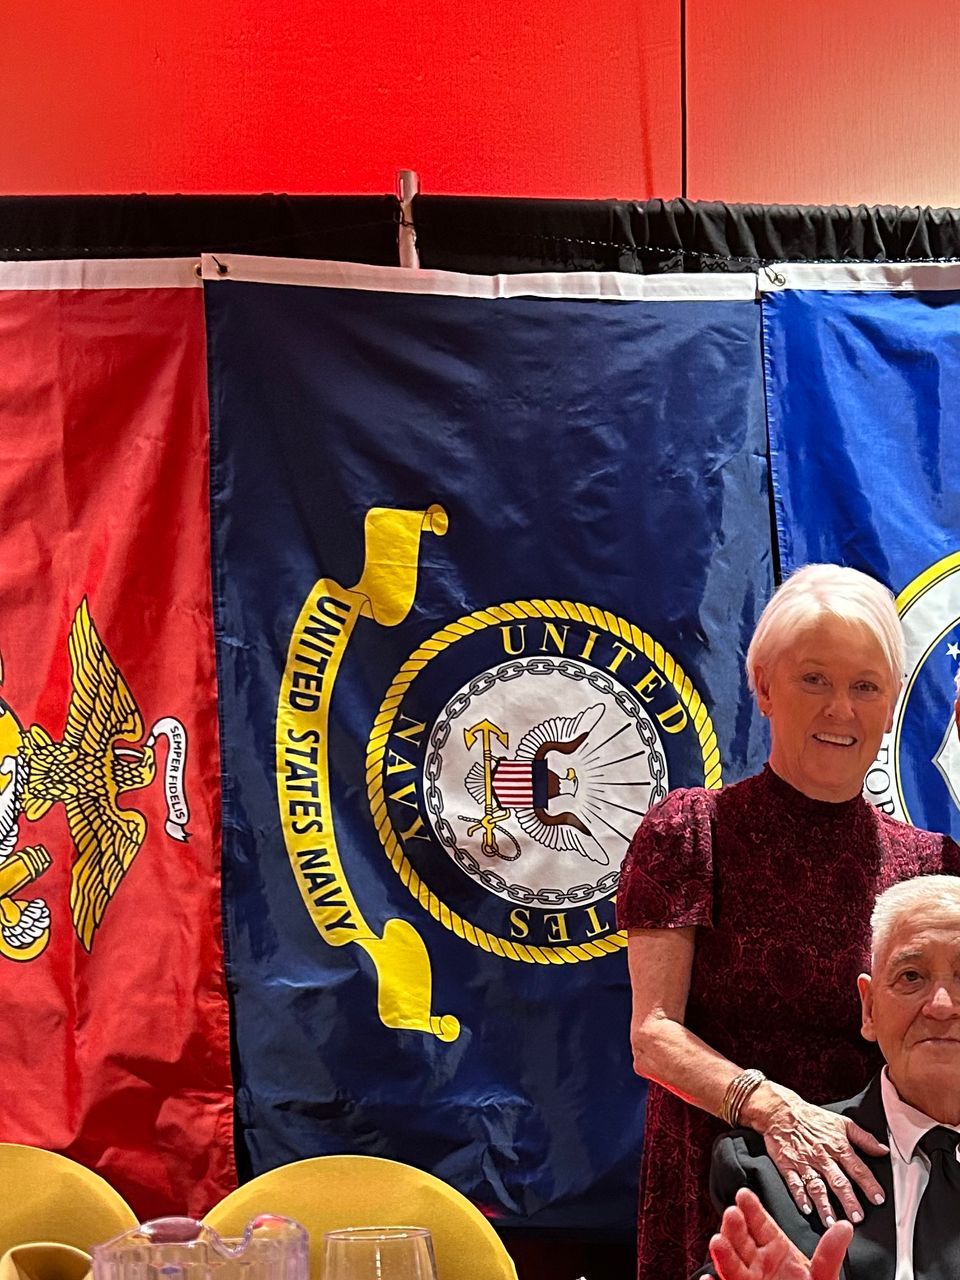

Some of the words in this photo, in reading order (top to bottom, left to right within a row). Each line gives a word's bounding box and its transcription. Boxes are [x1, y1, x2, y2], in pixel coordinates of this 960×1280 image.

[289, 596, 351, 712] UNITED
[499, 622, 688, 734] UNITED
[168, 775, 185, 819] FIDELIS
[170, 726, 182, 772] SEMPER
[285, 729, 323, 835] STATES
[386, 713, 432, 843] NAVY
[296, 848, 358, 932] NAVY
